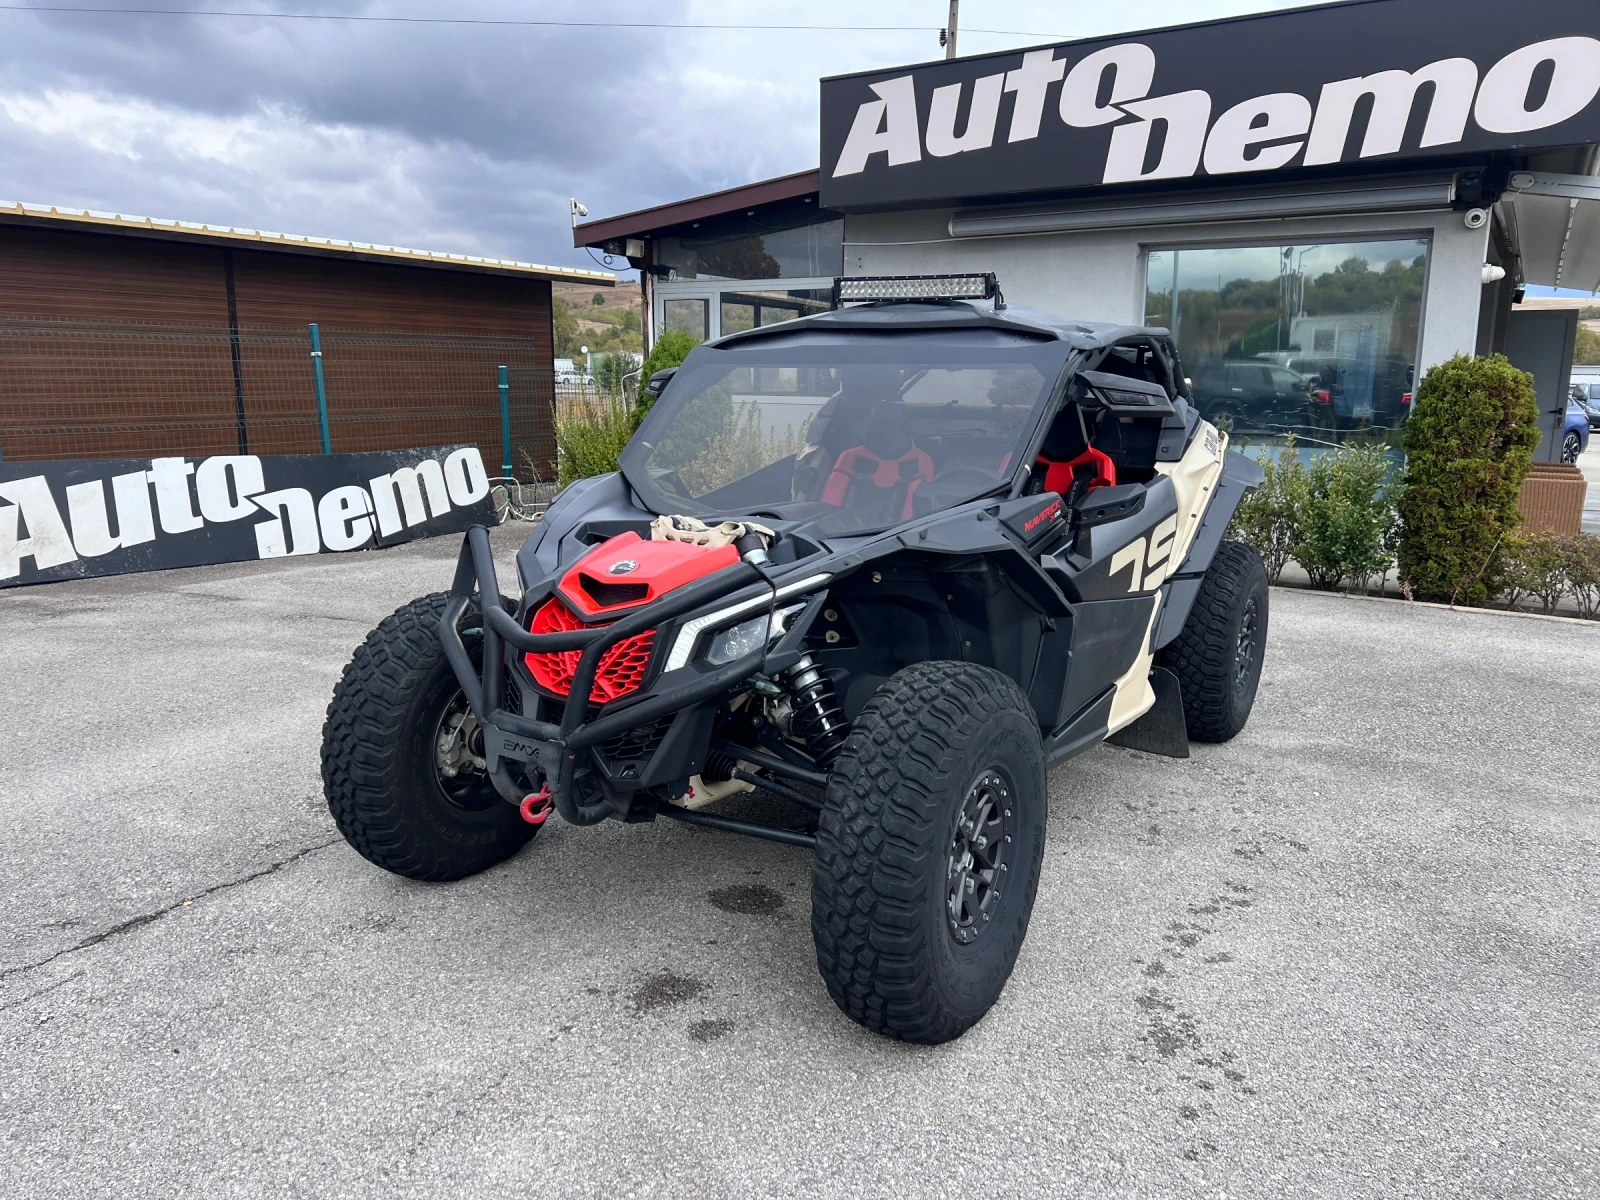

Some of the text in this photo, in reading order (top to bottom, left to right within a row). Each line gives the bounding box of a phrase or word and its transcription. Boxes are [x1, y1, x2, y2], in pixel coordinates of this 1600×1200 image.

[832, 36, 1600, 184] Auto Demo
[0, 447, 489, 580] Auto Demo
[1023, 499, 1060, 532] MAVERICK
